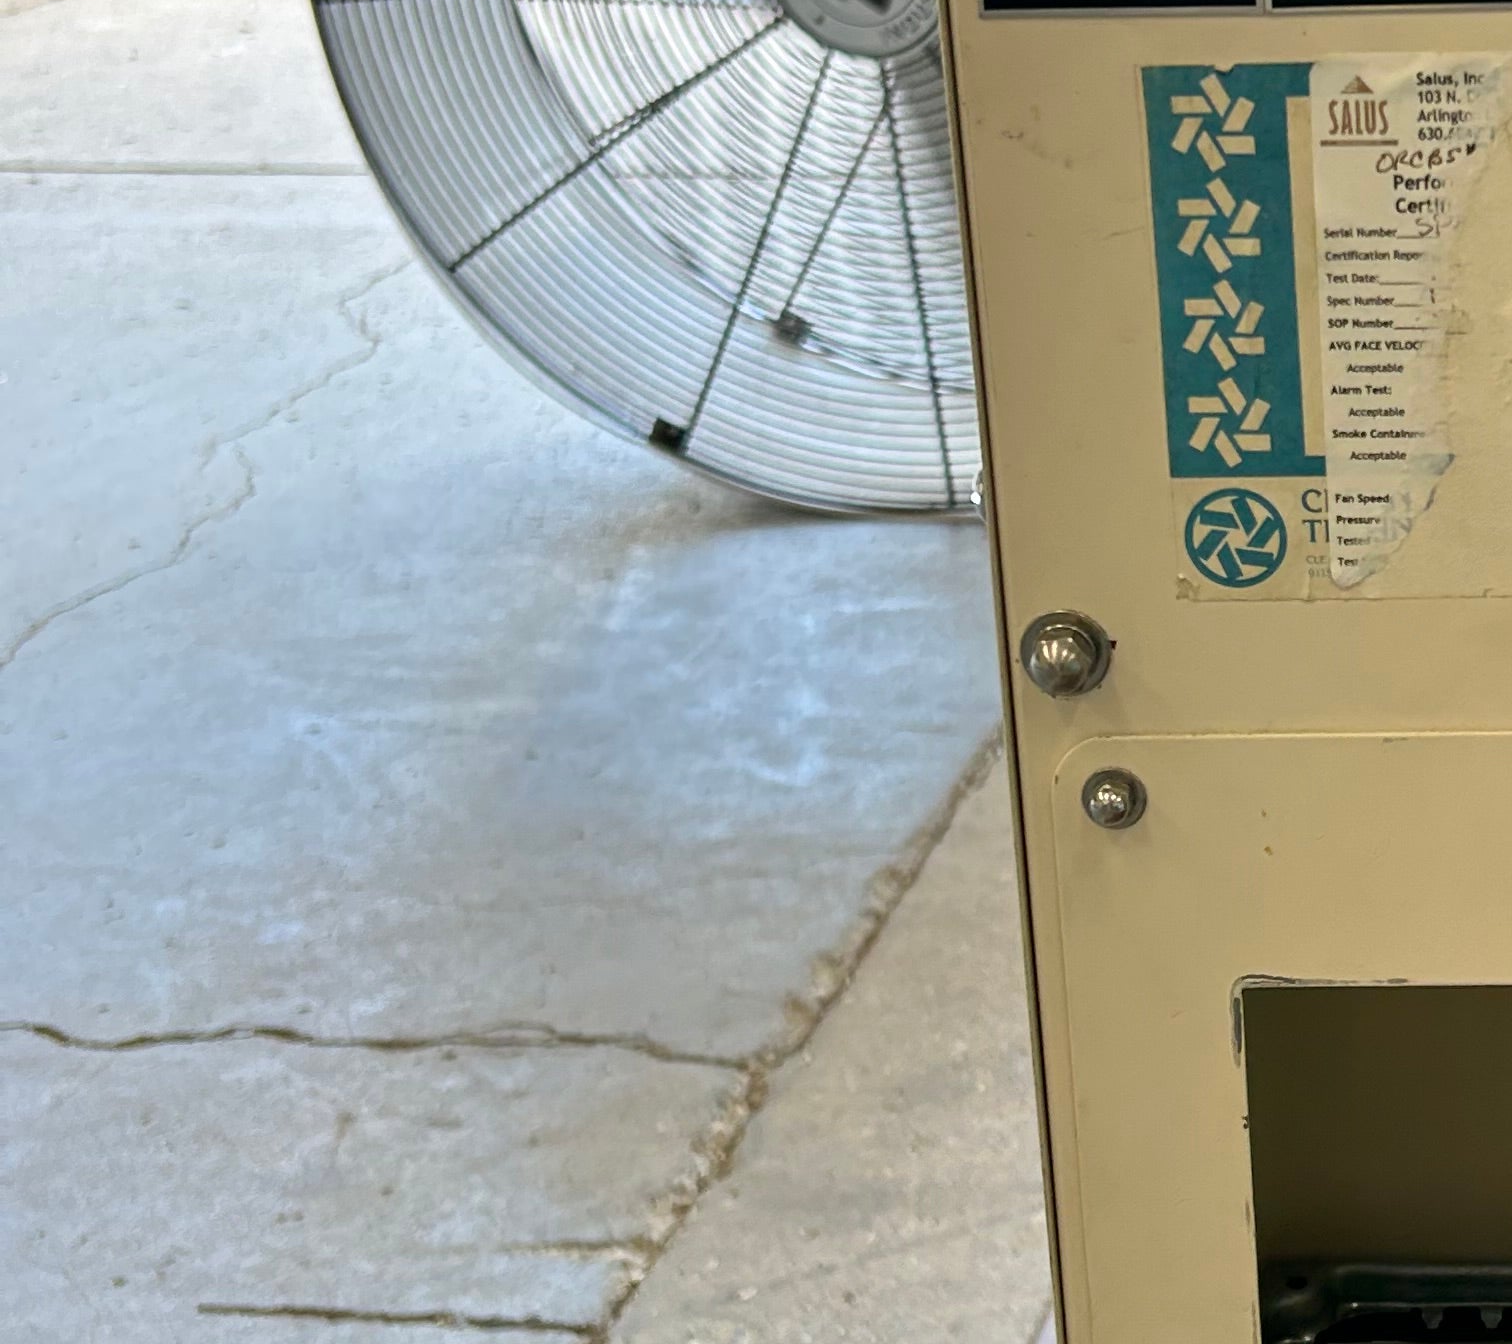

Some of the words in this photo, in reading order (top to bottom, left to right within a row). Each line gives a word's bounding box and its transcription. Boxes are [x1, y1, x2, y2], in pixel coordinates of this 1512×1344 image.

[1416, 70, 1460, 88] Salus,
[1417, 89, 1442, 105] 103
[1446, 89, 1462, 105] N.
[1328, 100, 1390, 136] SALUS
[1323, 227, 1354, 238] Serial
[1325, 249, 1391, 262] Certification
[1326, 273, 1349, 284] Test
[1327, 295, 1351, 310] Spec
[1328, 317, 1349, 329] SOP
[1328, 340, 1352, 352] AVG
[1354, 340, 1382, 351] FACE
[1347, 363, 1405, 375] Acceptable
[1331, 385, 1362, 395] Alarm
[1348, 407, 1406, 419] Acceptable
[1331, 429, 1368, 439] Smoke
[1350, 451, 1408, 462] Acceptable
[1334, 493, 1355, 504] Fan
